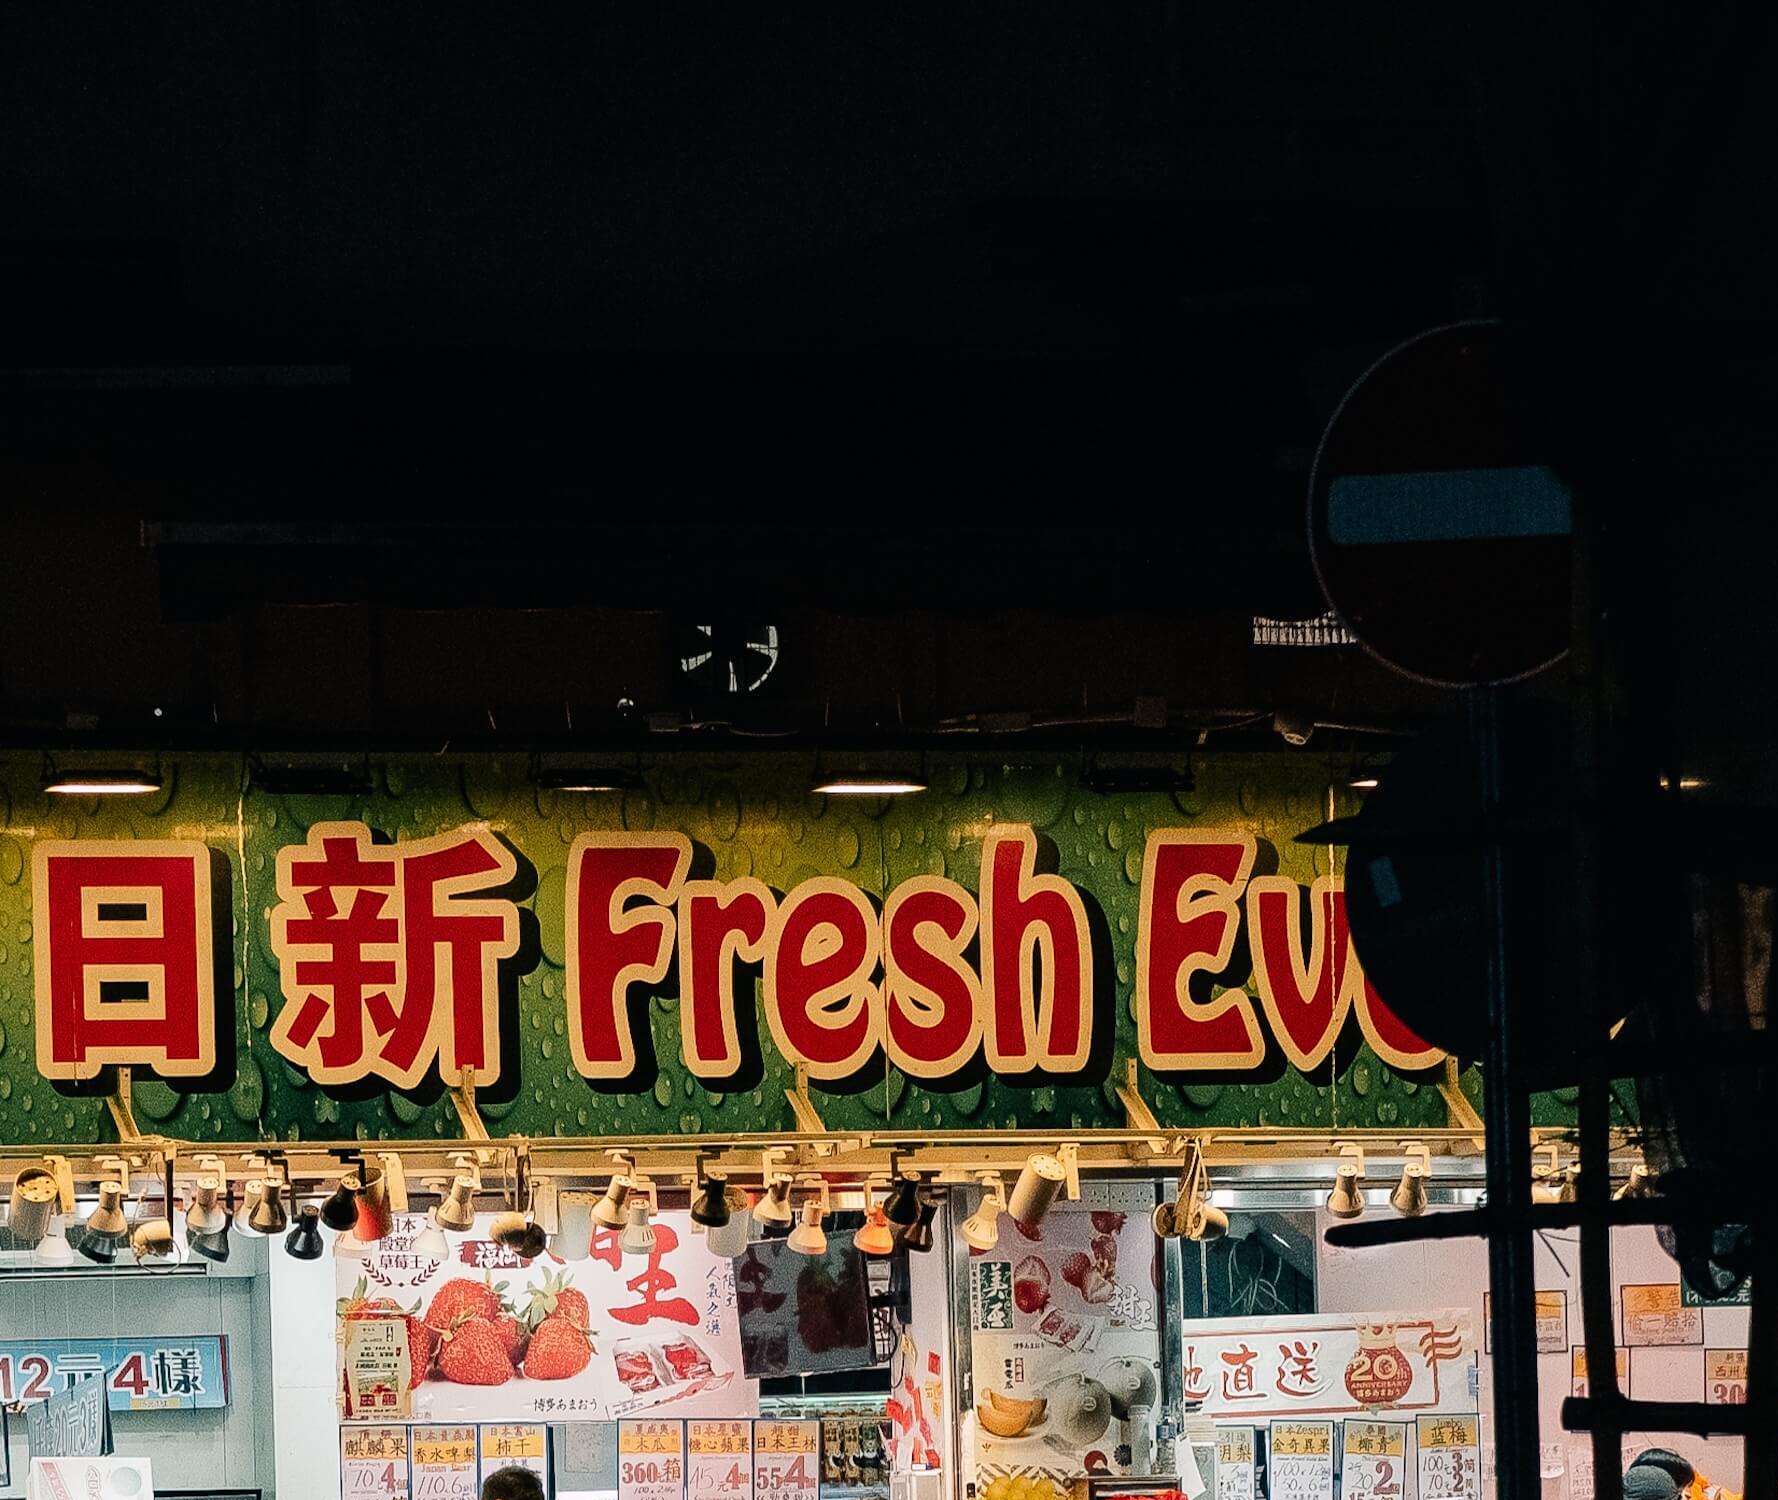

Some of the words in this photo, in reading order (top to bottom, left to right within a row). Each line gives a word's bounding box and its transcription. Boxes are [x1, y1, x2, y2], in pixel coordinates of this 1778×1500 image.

[32, 820, 519, 1088] 日新
[567, 822, 1097, 1081] Fresh
[378, 1253, 425, 1270] 草莓王
[344, 1438, 408, 1458] 麒麟果
[635, 1437, 666, 1451] 木瓜
[756, 1436, 817, 1449] 日本王林
[1273, 1437, 1330, 1453] 金奇異果
[1358, 1436, 1392, 1453] 椰青
[414, 1447, 476, 1463] 香水啤梨
